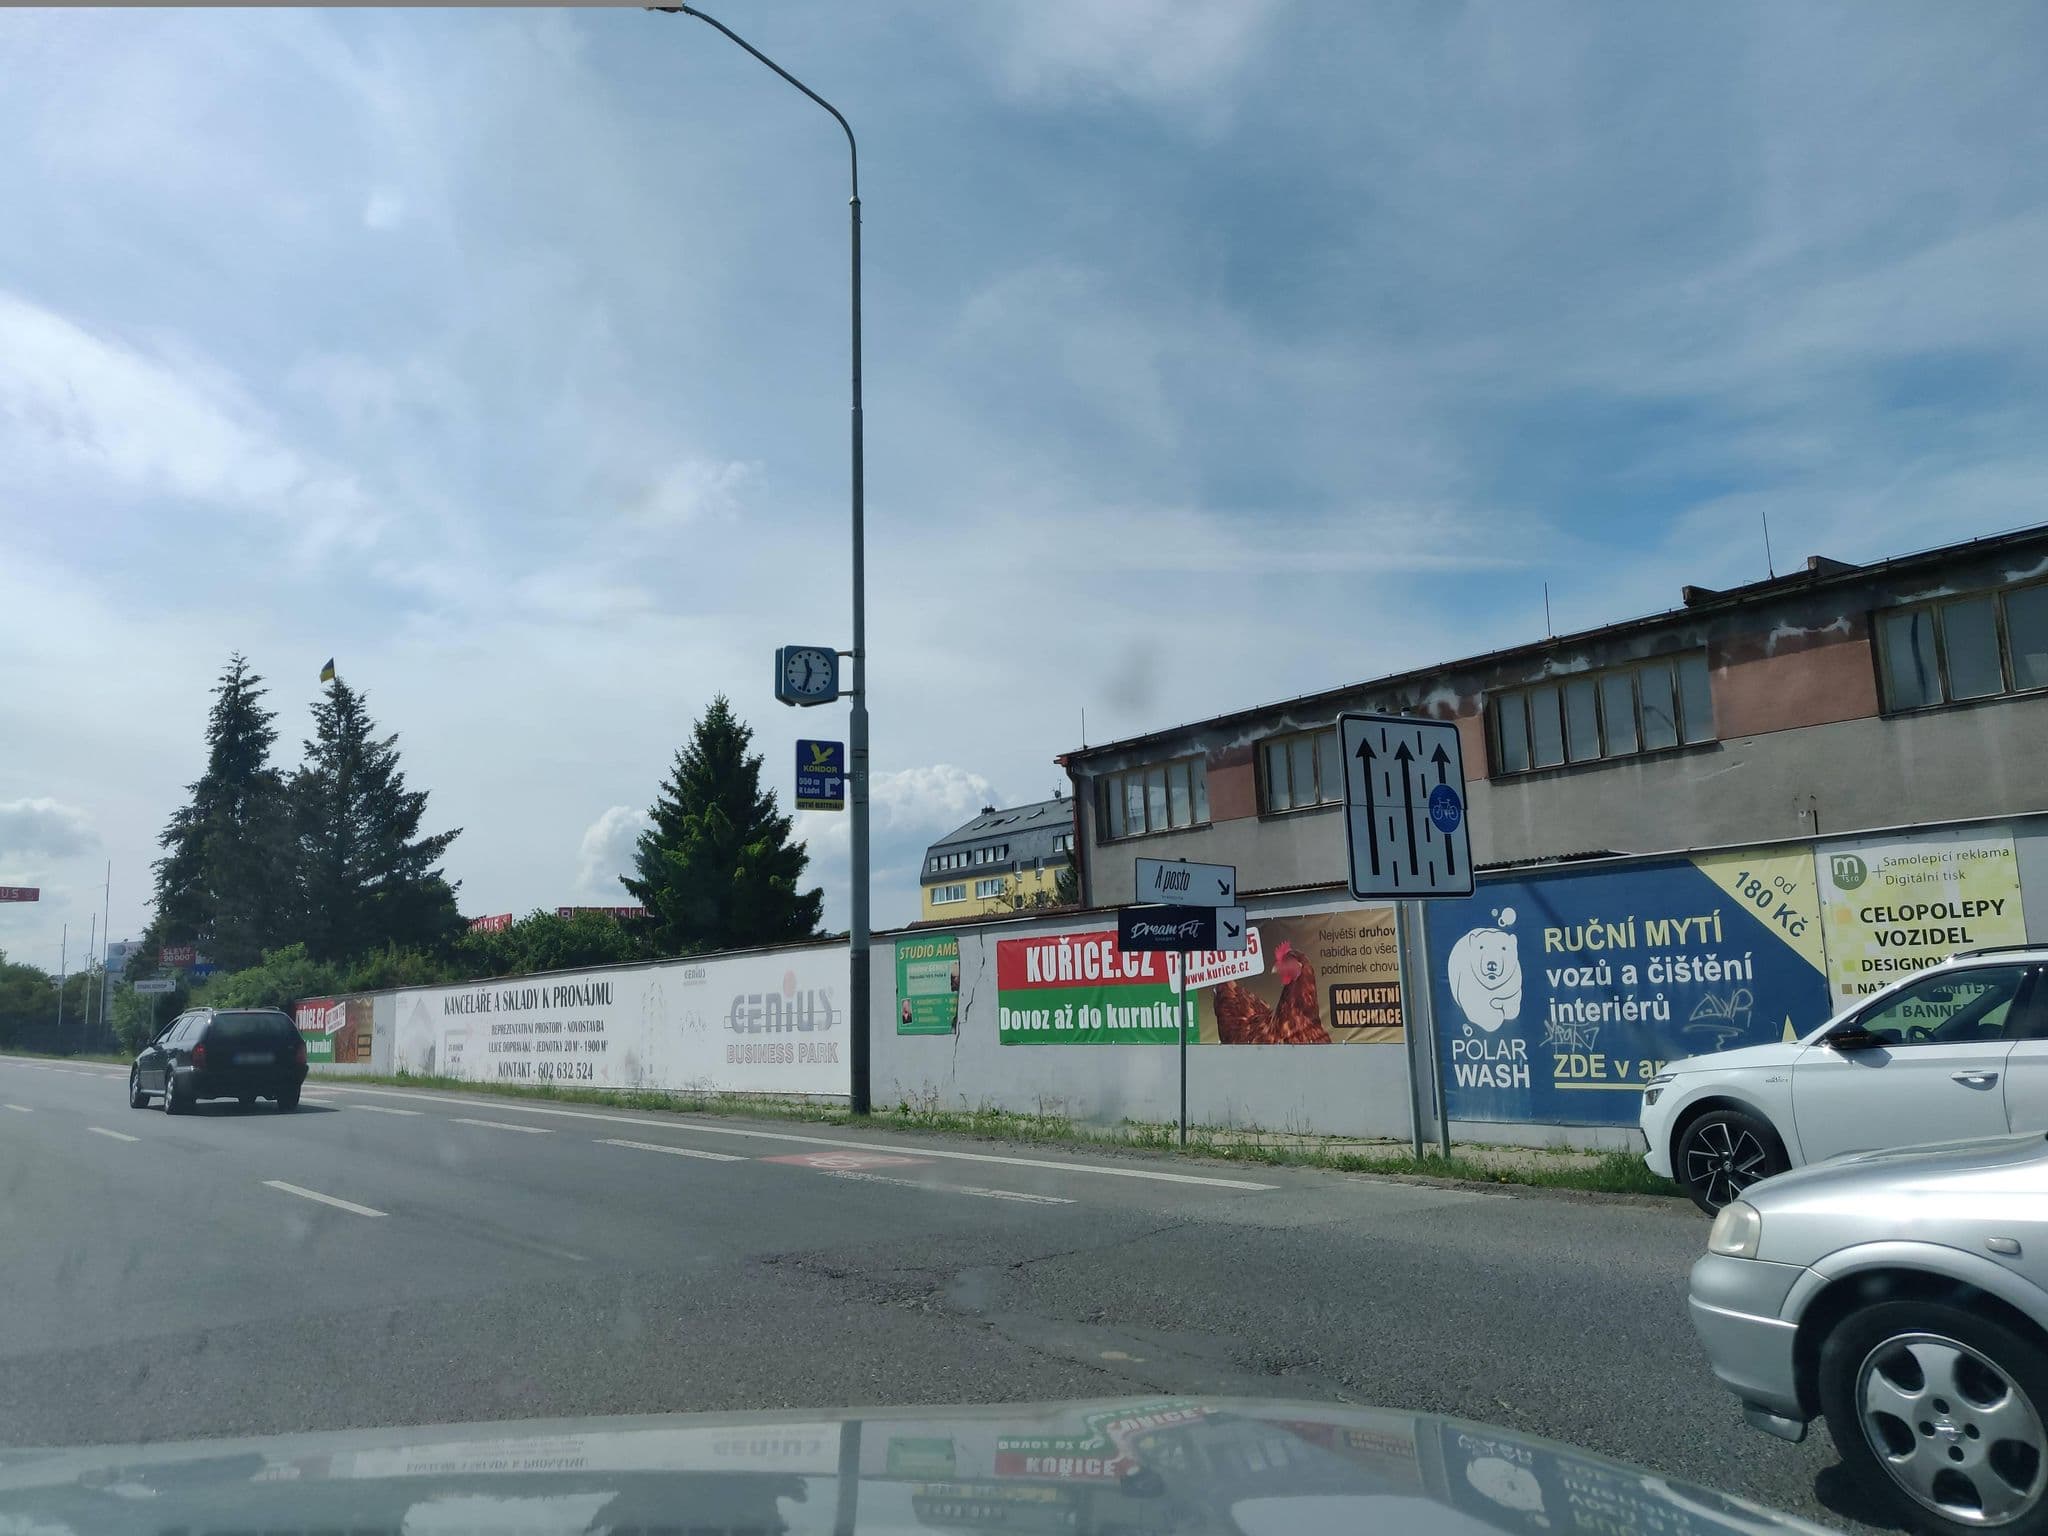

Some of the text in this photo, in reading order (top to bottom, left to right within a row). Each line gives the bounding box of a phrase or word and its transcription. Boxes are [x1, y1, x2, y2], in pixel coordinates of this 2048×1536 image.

[803, 765, 838, 774] KONDOR
[1957, 847, 2010, 861] reklama
[1155, 865, 1191, 893] A posto
[1943, 869, 1966, 881] tisk
[1774, 876, 1797, 895] od
[1735, 871, 1808, 937] 180 Kč
[1860, 899, 2005, 924] CELOPOLEPY
[1359, 925, 1397, 938] druhov
[1544, 909, 1722, 952] RUČNÍ MYTÍ
[1875, 927, 1974, 947] VOZIDEL
[900, 944, 934, 960] STUDIO
[1026, 937, 1155, 983] KUŘICE.CZ
[1320, 943, 1398, 958] nabídka do všec
[1321, 962, 1368, 977] podmínek
[1546, 951, 1753, 987] vozů a čištění
[444, 978, 614, 1016] KANCELÁŘE A SKLADY K PRONÁJMU
[1335, 984, 1400, 1005] KOMPLETNÍ
[1858, 980, 1893, 995] NAŽ
[1000, 1007, 1050, 1031] Dovoz
[1054, 1003, 1074, 1030] až
[1078, 1004, 1102, 1029] do
[1336, 1008, 1402, 1025] VAKCINACE
[1549, 993, 1670, 1023] interiérů
[567, 1019, 604, 1033] NOVOSTAVBA
[564, 1040, 572, 1052] 20
[584, 1039, 600, 1052] 1900
[727, 1042, 839, 1064] BUSINESS PARK
[1452, 1039, 1528, 1061] POLAR
[498, 1061, 593, 1080] KONTAKT 602 632 524
[1454, 1064, 1531, 1089] WASH
[1553, 1054, 1608, 1079] ZDE
[1613, 1060, 1630, 1079] v
